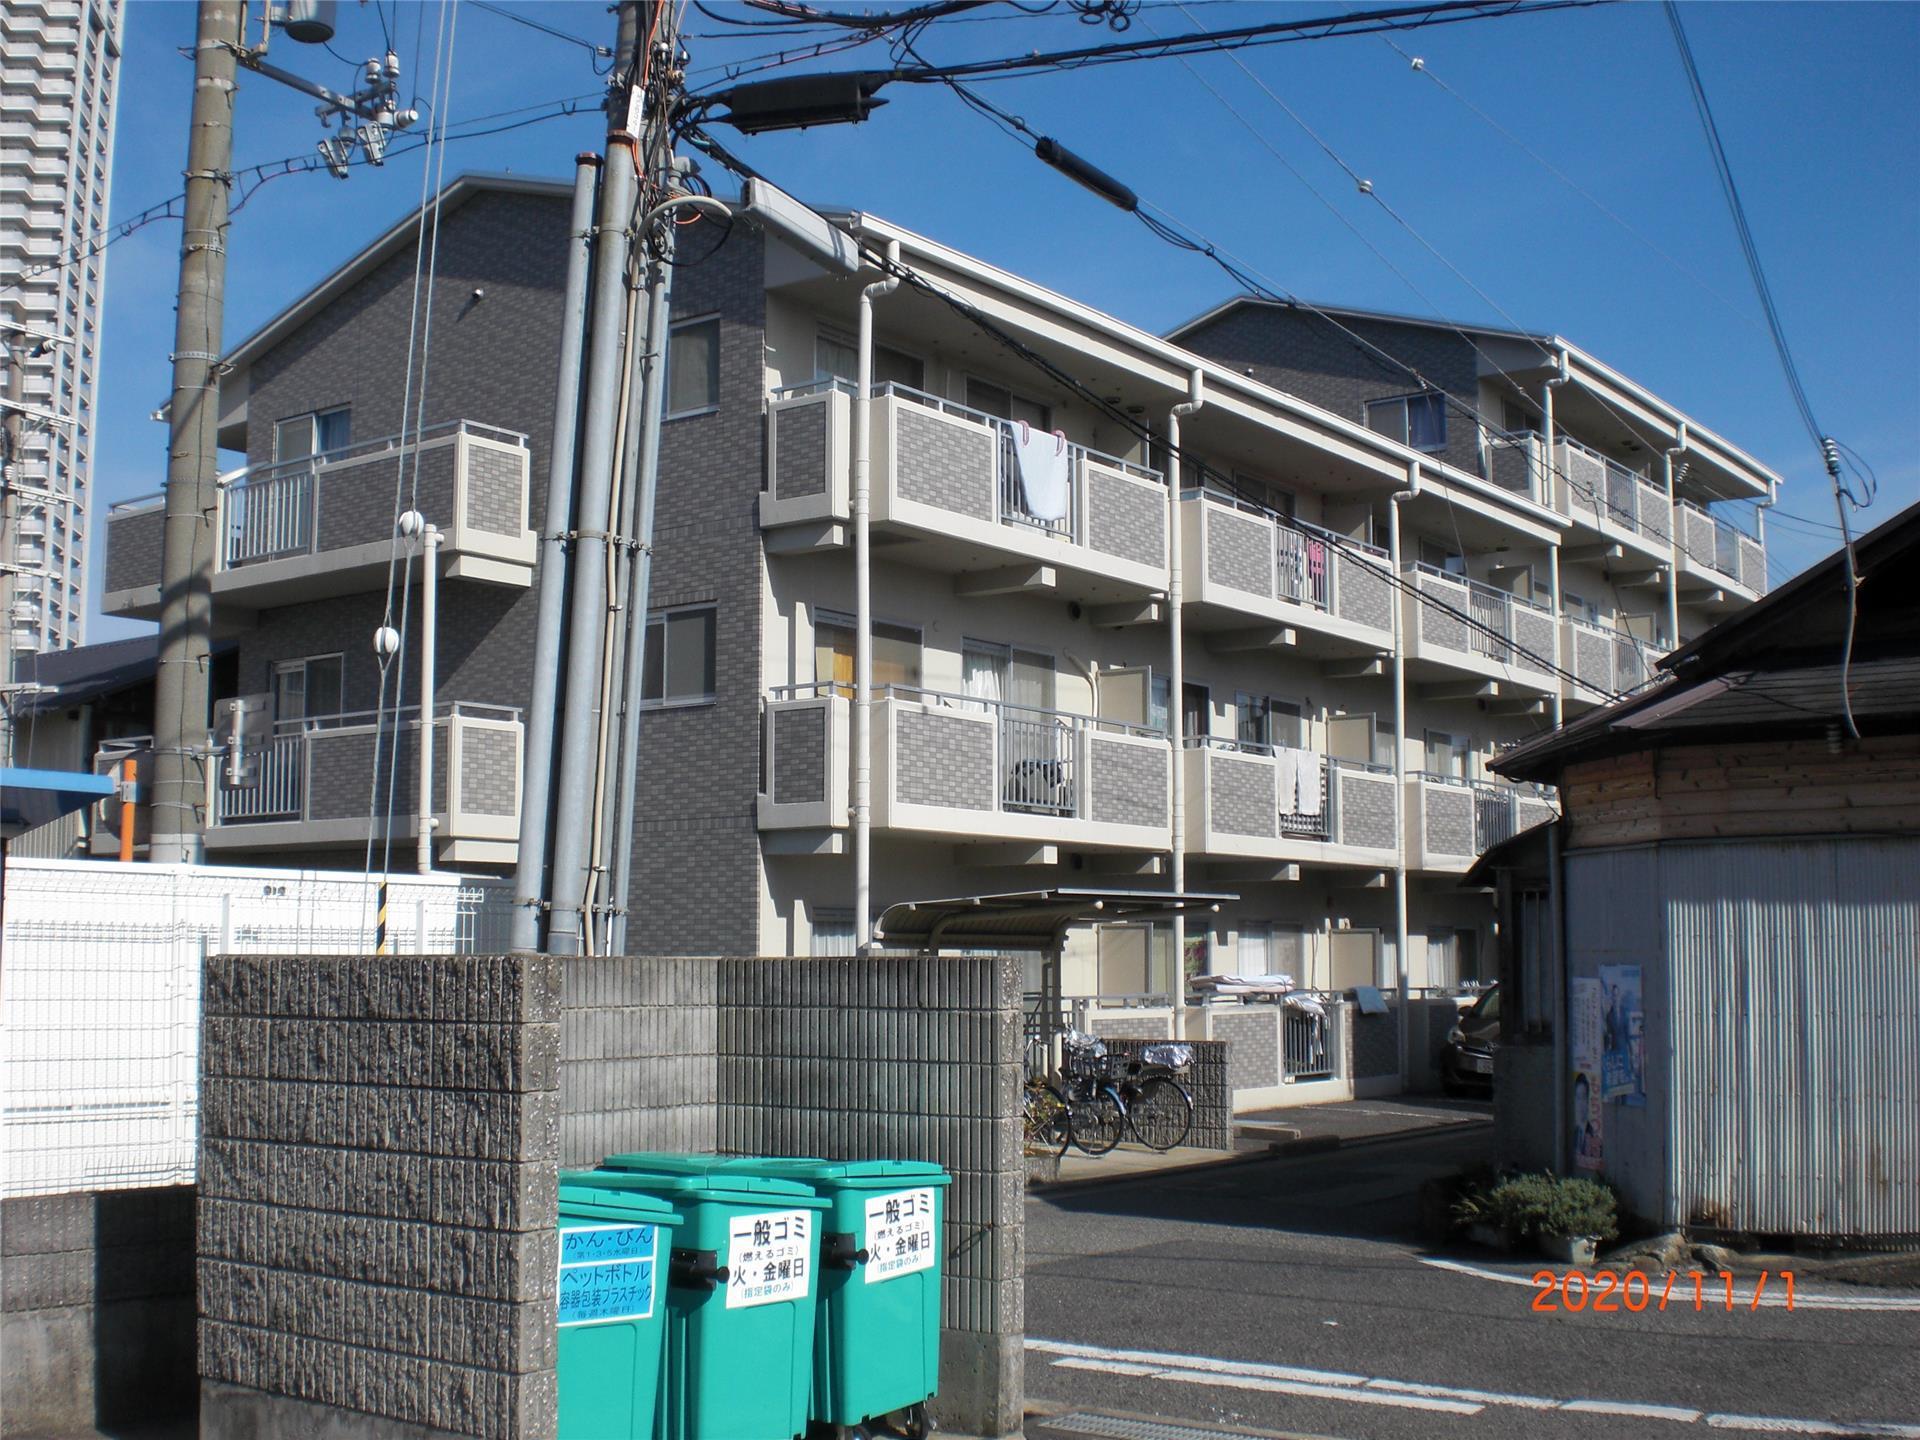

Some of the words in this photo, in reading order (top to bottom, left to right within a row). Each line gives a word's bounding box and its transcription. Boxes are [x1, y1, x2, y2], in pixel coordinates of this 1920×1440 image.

[869, 1193, 929, 1224] 一般ゴミ
[566, 1228, 653, 1250] かん・びん
[734, 1216, 805, 1246] 一般ゴミ
[870, 1231, 930, 1264] 火・金曜日
[563, 1263, 650, 1288] ペットボトル
[732, 1258, 804, 1287] 火・金曜日
